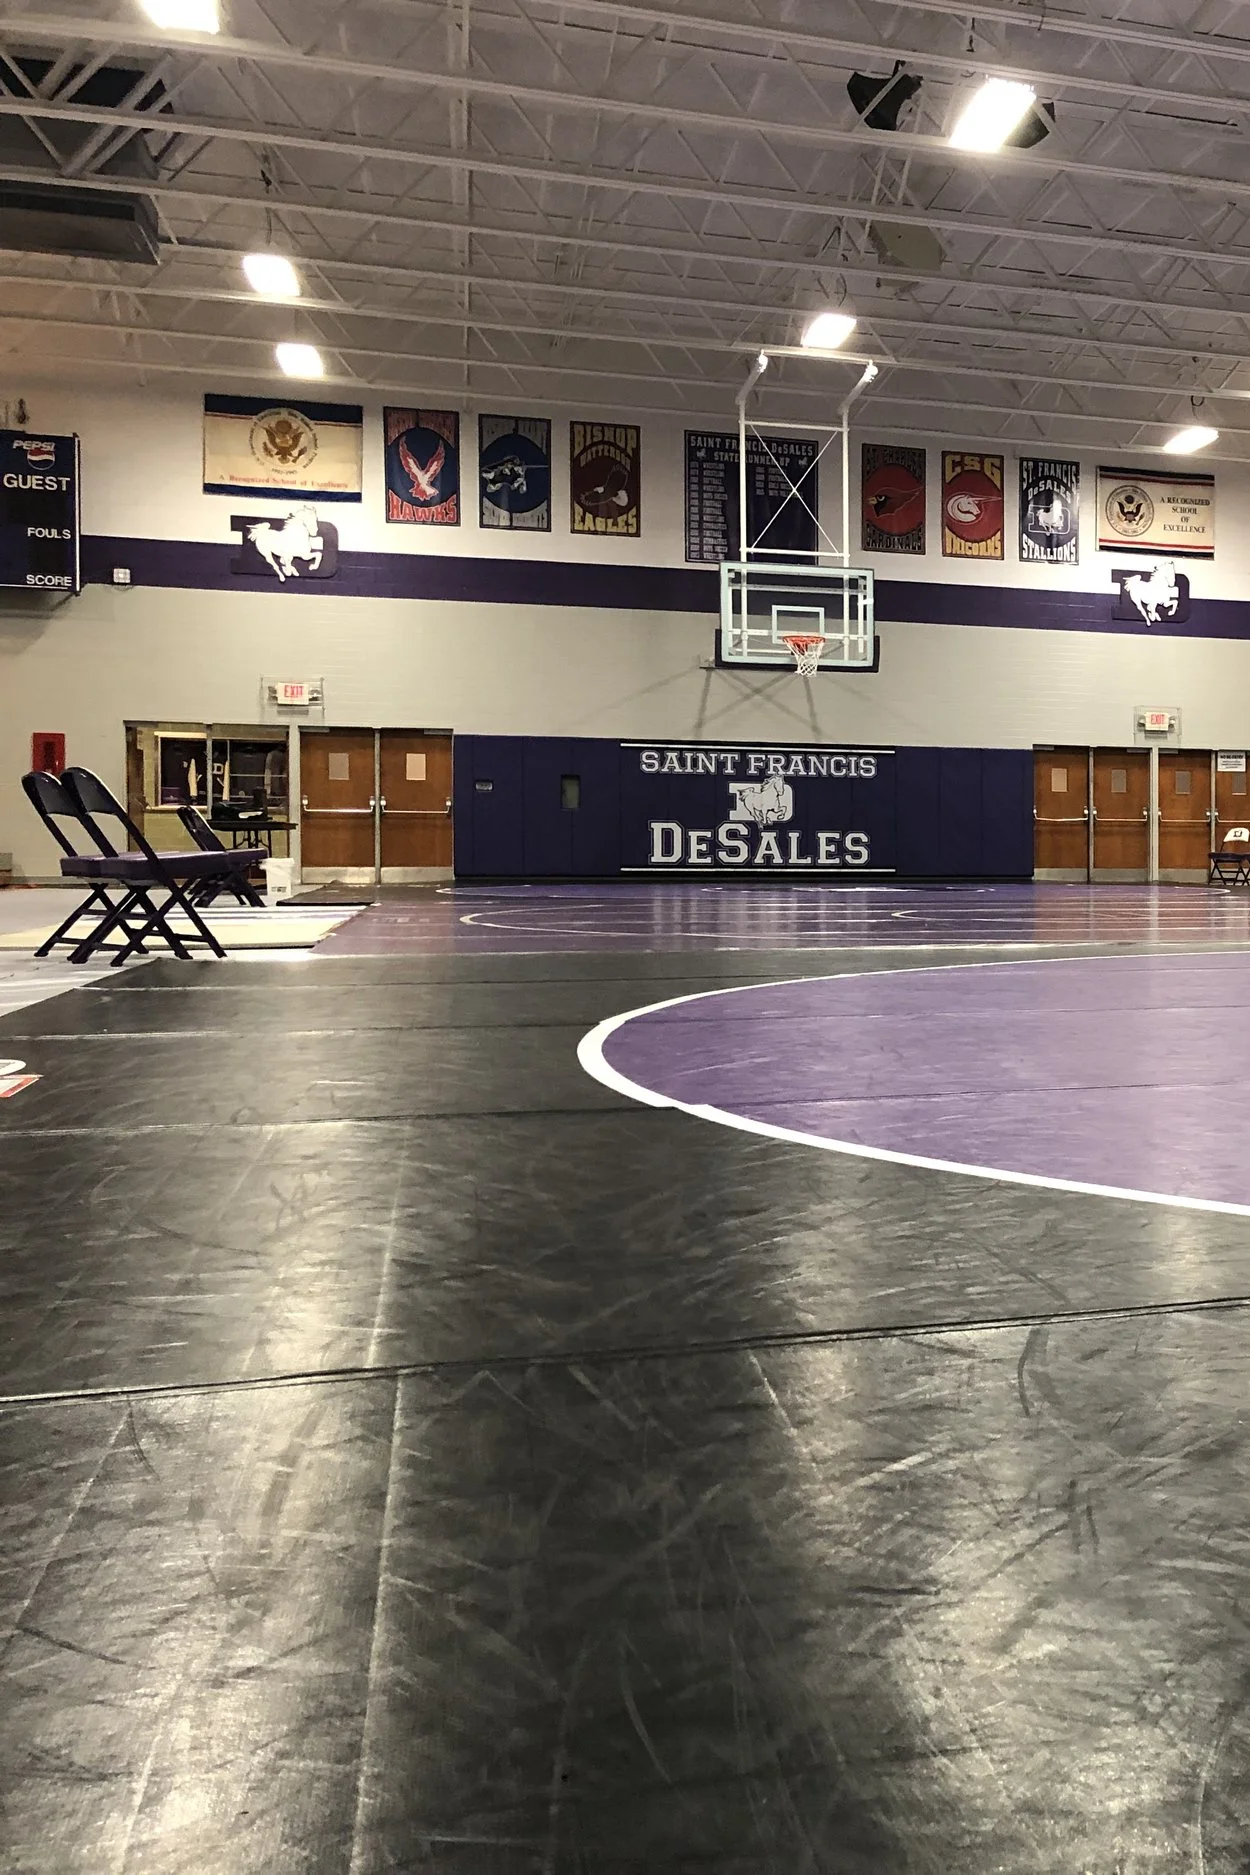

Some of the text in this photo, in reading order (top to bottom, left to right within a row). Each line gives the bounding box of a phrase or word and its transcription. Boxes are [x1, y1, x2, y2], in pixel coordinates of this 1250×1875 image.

[12, 439, 56, 452] PEPSI
[573, 424, 637, 458] BISHOP
[690, 435, 814, 457] SAINT FRNCIS DeSALES
[713, 451, 740, 463] STATE
[3, 473, 71, 492] GUEST
[1022, 461, 1077, 495] ST. FRANCIS
[1027, 479, 1072, 504] DeSALES
[388, 489, 457, 524] HAWKS
[1167, 497, 1211, 506] RECOGNIZED
[574, 502, 637, 534] EAGLES
[1171, 506, 1198, 515] SCHOOL
[27, 527, 72, 540] FOULS
[1163, 524, 1206, 534] EXCELLENCE
[1022, 533, 1076, 562] STALLIONS
[26, 574, 73, 588] SCORE
[284, 684, 304, 698] EXIT
[1150, 713, 1165, 725] EXIT
[640, 751, 878, 777] SAINT FRANCIS
